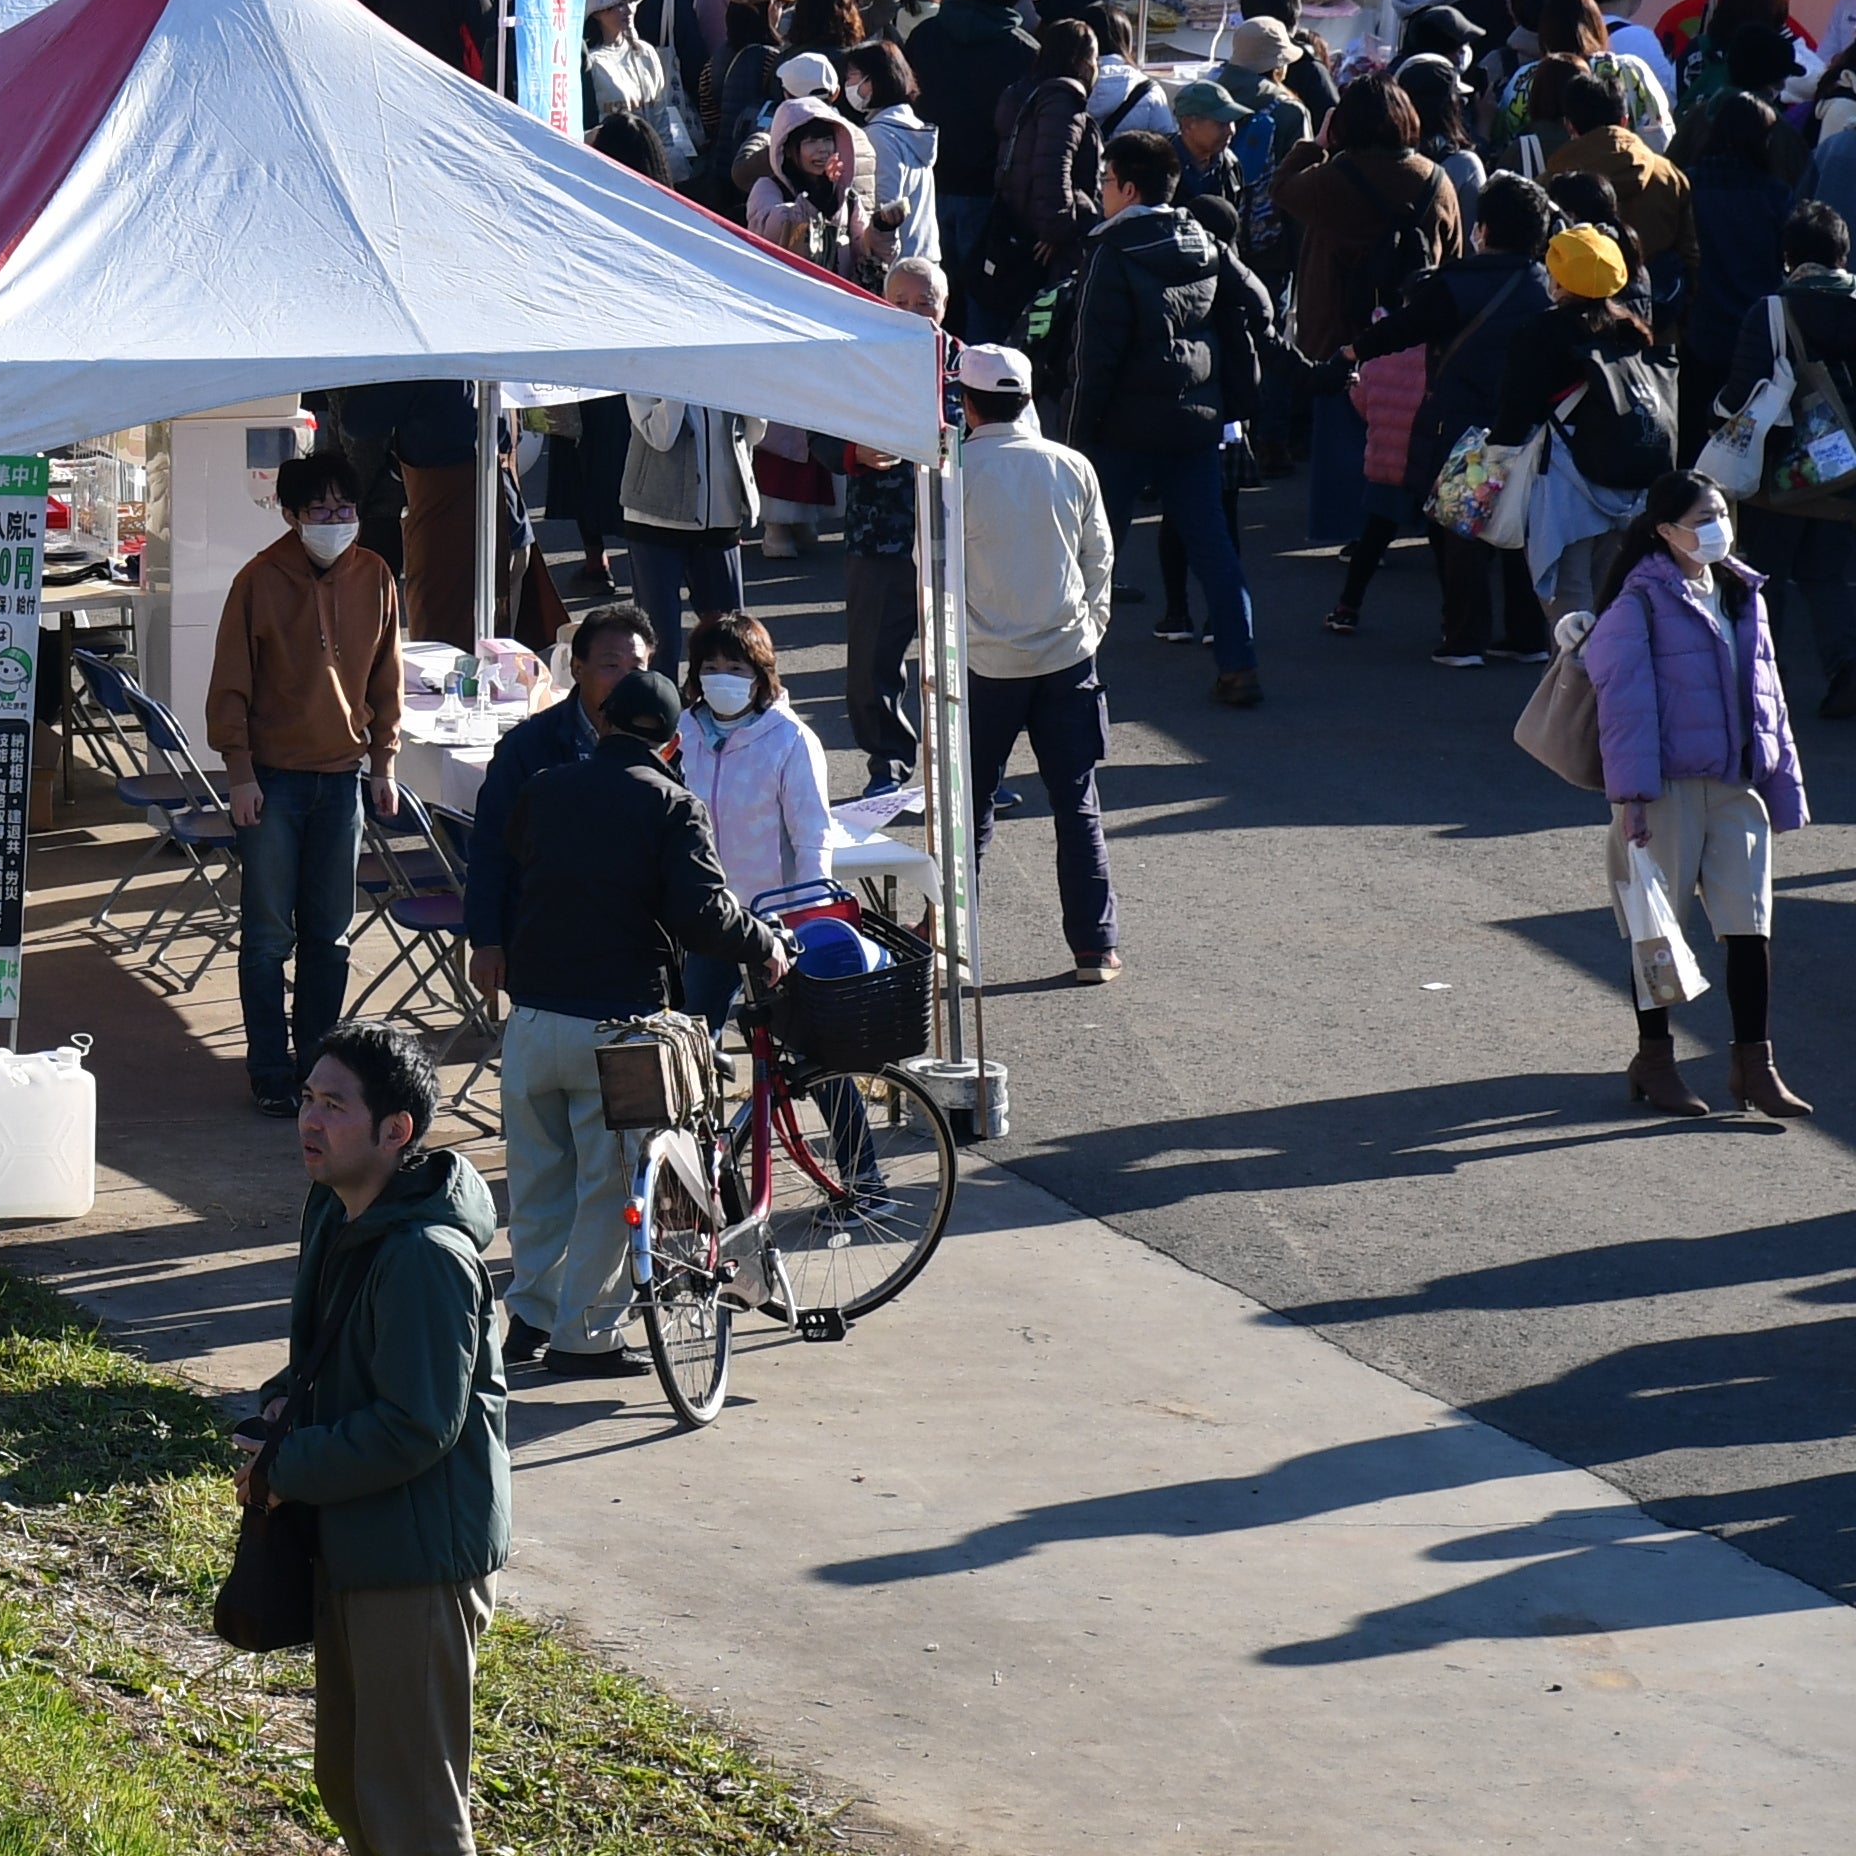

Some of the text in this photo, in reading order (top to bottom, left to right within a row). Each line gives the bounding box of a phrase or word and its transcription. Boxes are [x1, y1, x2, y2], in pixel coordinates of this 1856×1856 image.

[4, 732, 26, 901] 納税相談・建退共・労災
